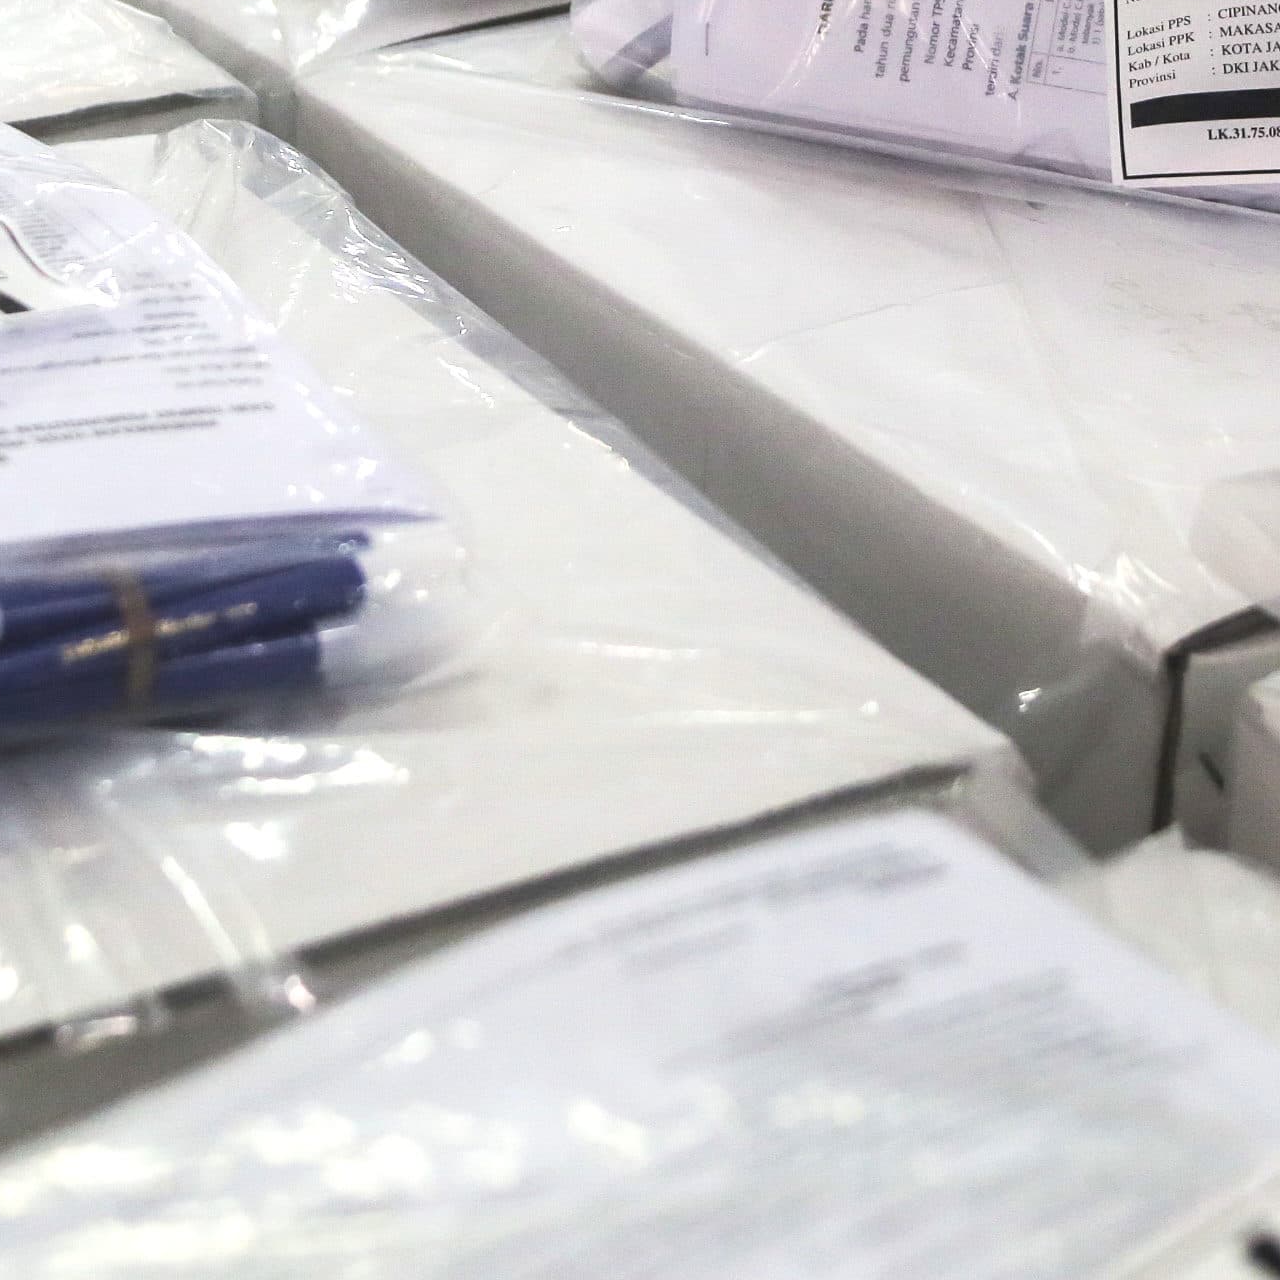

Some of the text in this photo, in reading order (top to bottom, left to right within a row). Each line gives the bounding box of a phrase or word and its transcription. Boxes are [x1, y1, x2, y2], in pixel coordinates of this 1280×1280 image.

[1017, 1, 1036, 41] Suara
[1126, 15, 1192, 40] Lokasi PPS
[853, 22, 871, 53] Pada
[873, 12, 895, 78] tahun dua
[897, 1, 924, 82] pemungutan
[923, 20, 942, 65] Nomor
[1127, 32, 1196, 56] Lokasi PPK
[1221, 41, 1262, 57] KOTA
[1009, 43, 1027, 85] Kotak
[1128, 51, 1191, 73] Kab Kota
[1222, 61, 1251, 75] DKI
[1128, 70, 1177, 89] Provinsi
